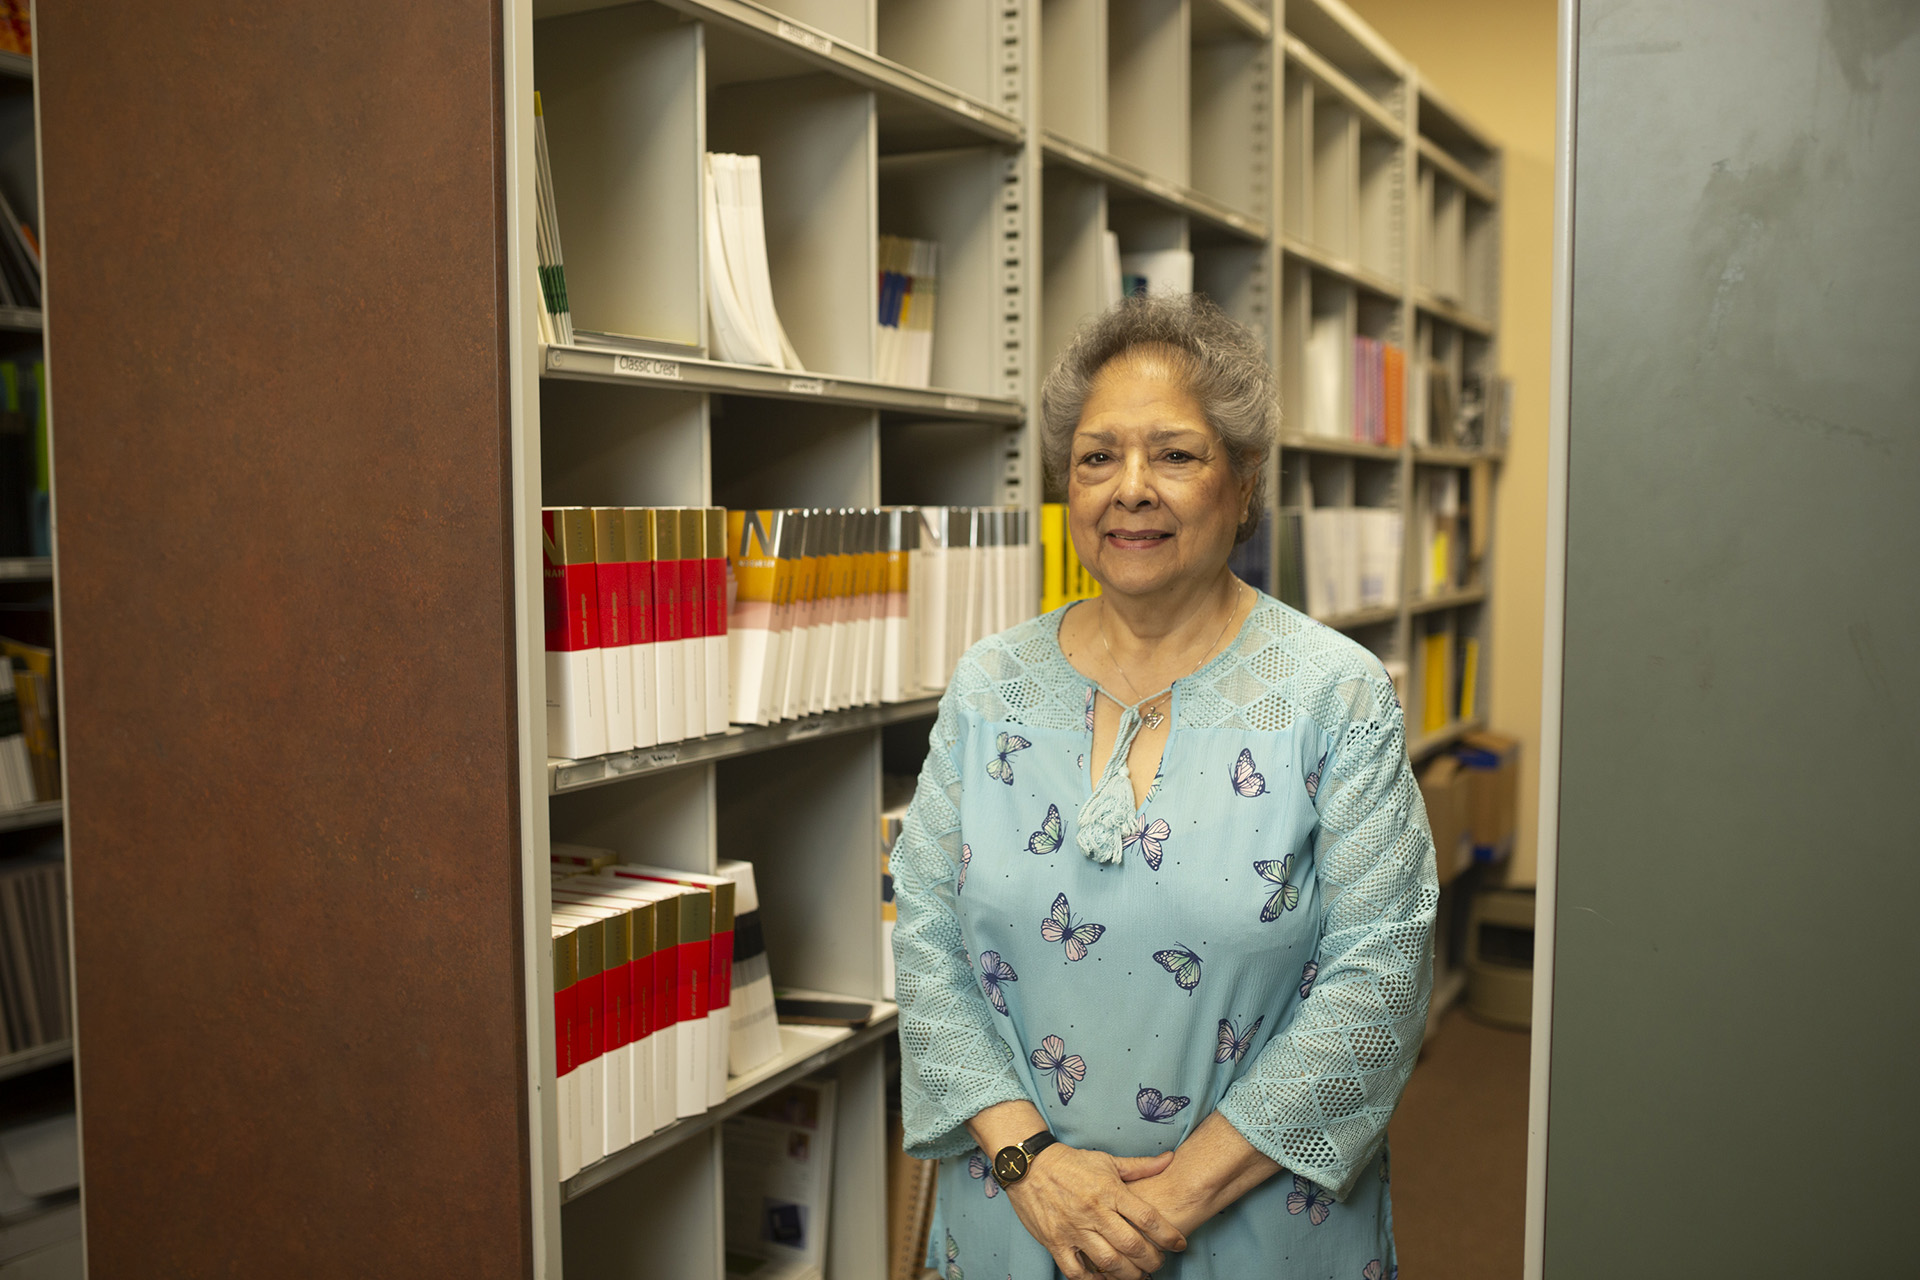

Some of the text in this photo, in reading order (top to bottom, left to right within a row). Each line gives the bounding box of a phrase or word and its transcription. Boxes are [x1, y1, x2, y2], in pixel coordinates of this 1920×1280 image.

[619, 355, 677, 377] Classic Crest
[740, 510, 783, 558] N
